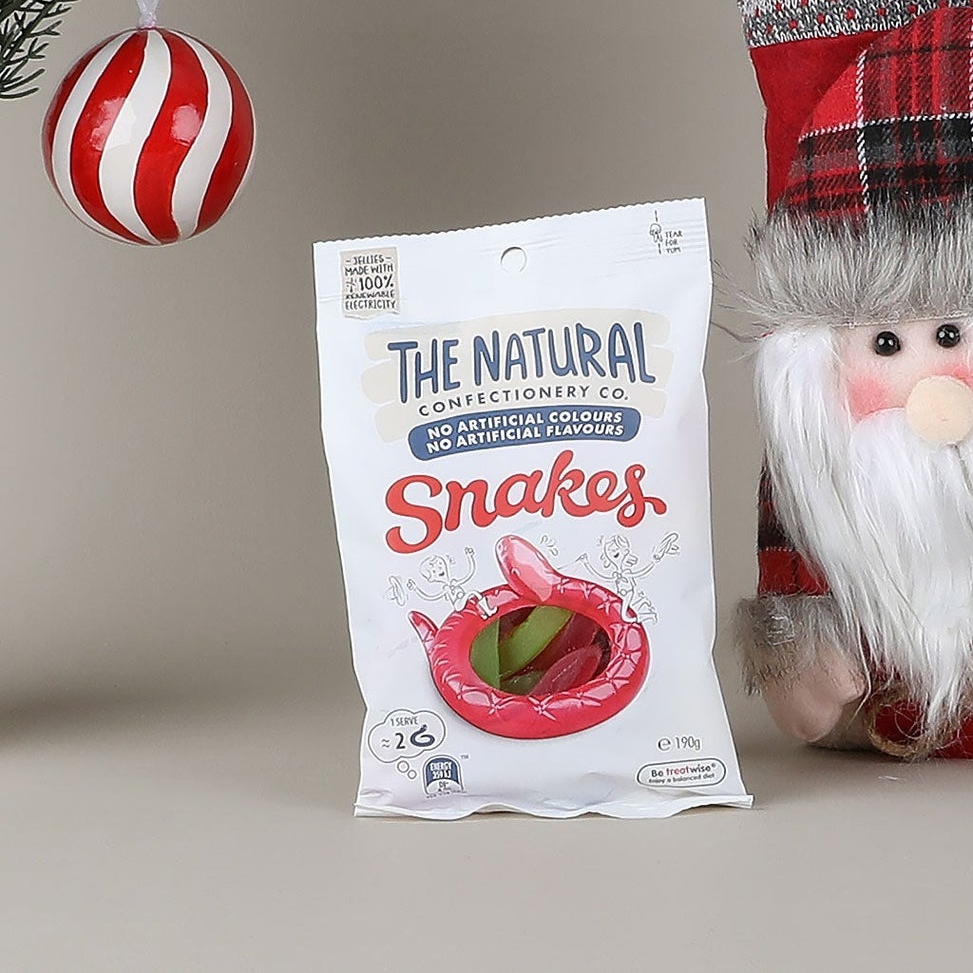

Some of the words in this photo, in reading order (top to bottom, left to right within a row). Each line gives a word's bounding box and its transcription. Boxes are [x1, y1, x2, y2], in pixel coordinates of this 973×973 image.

[352, 254, 385, 266] JELLIES
[344, 265, 370, 277] MADE
[370, 262, 394, 274] WITH
[359, 273, 395, 292] 100%
[344, 299, 396, 311] ELECTRICITY
[388, 339, 461, 403] THE
[473, 322, 657, 387] NATURAL
[418, 384, 591, 417] CONFECTIONERY
[599, 385, 630, 402] CO.
[427, 424, 453, 441] NO
[457, 413, 545, 434] ARTIFICIAL
[548, 410, 624, 425] COLOURS
[425, 440, 452, 455] NO
[456, 428, 542, 449] ARTIFICIAL
[546, 424, 625, 439] FLAVOURS
[385, 449, 668, 554] Snakes
[396, 715, 418, 727] SERVE
[395, 732, 406, 749] 2
[675, 736, 700, 751] 190g
[651, 769, 665, 778] Be
[673, 774, 701, 782] balanced
